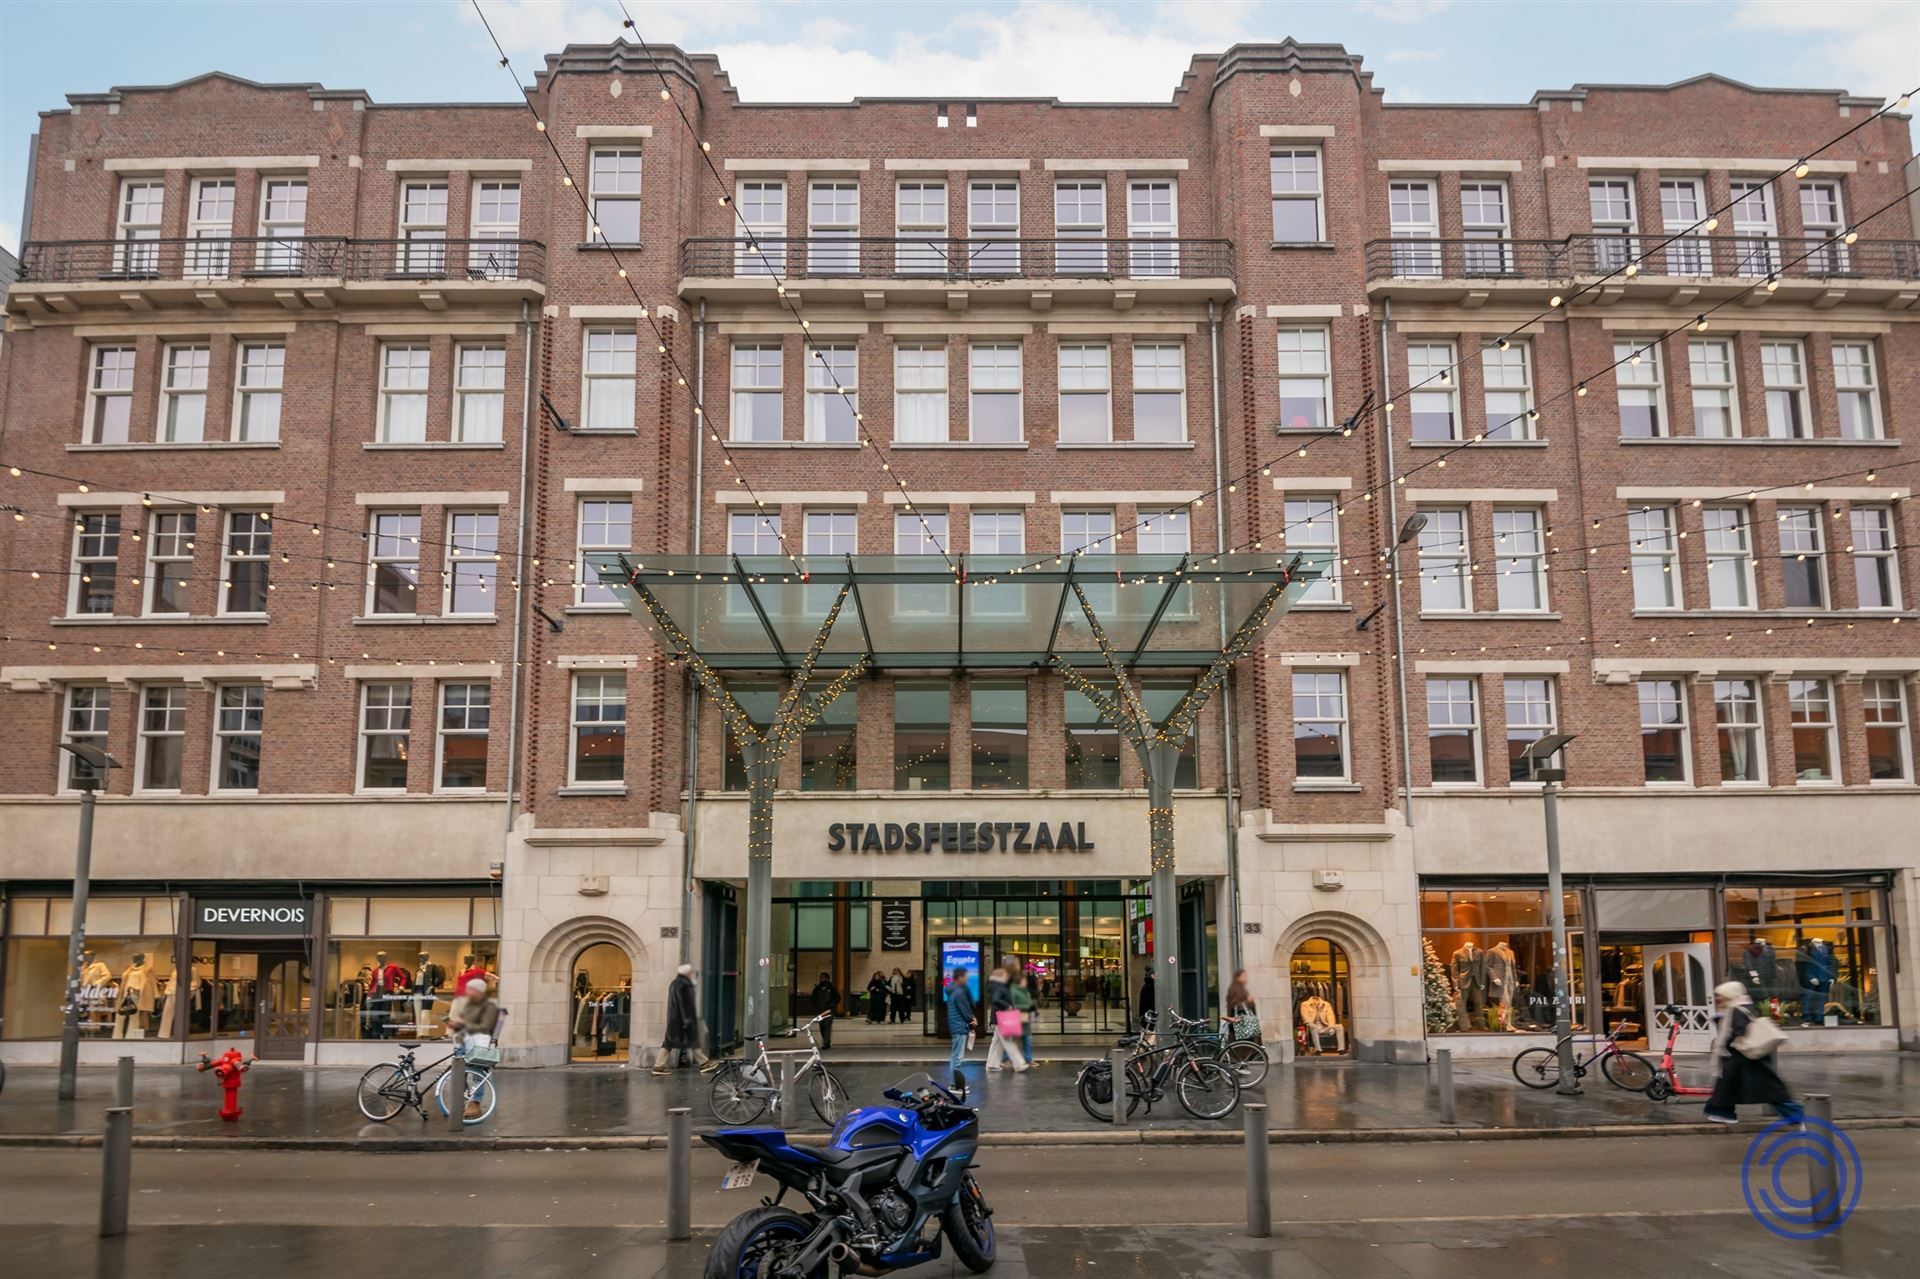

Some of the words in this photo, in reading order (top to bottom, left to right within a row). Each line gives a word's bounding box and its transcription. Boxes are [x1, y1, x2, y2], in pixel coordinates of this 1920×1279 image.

[828, 821, 1095, 852] STADSFEESTZAAL
[203, 907, 305, 923] DEVERNOIS
[662, 927, 677, 938] 29
[1246, 923, 1261, 933] 33
[945, 955, 976, 966] Egypte
[1529, 996, 1549, 1005] PAL
